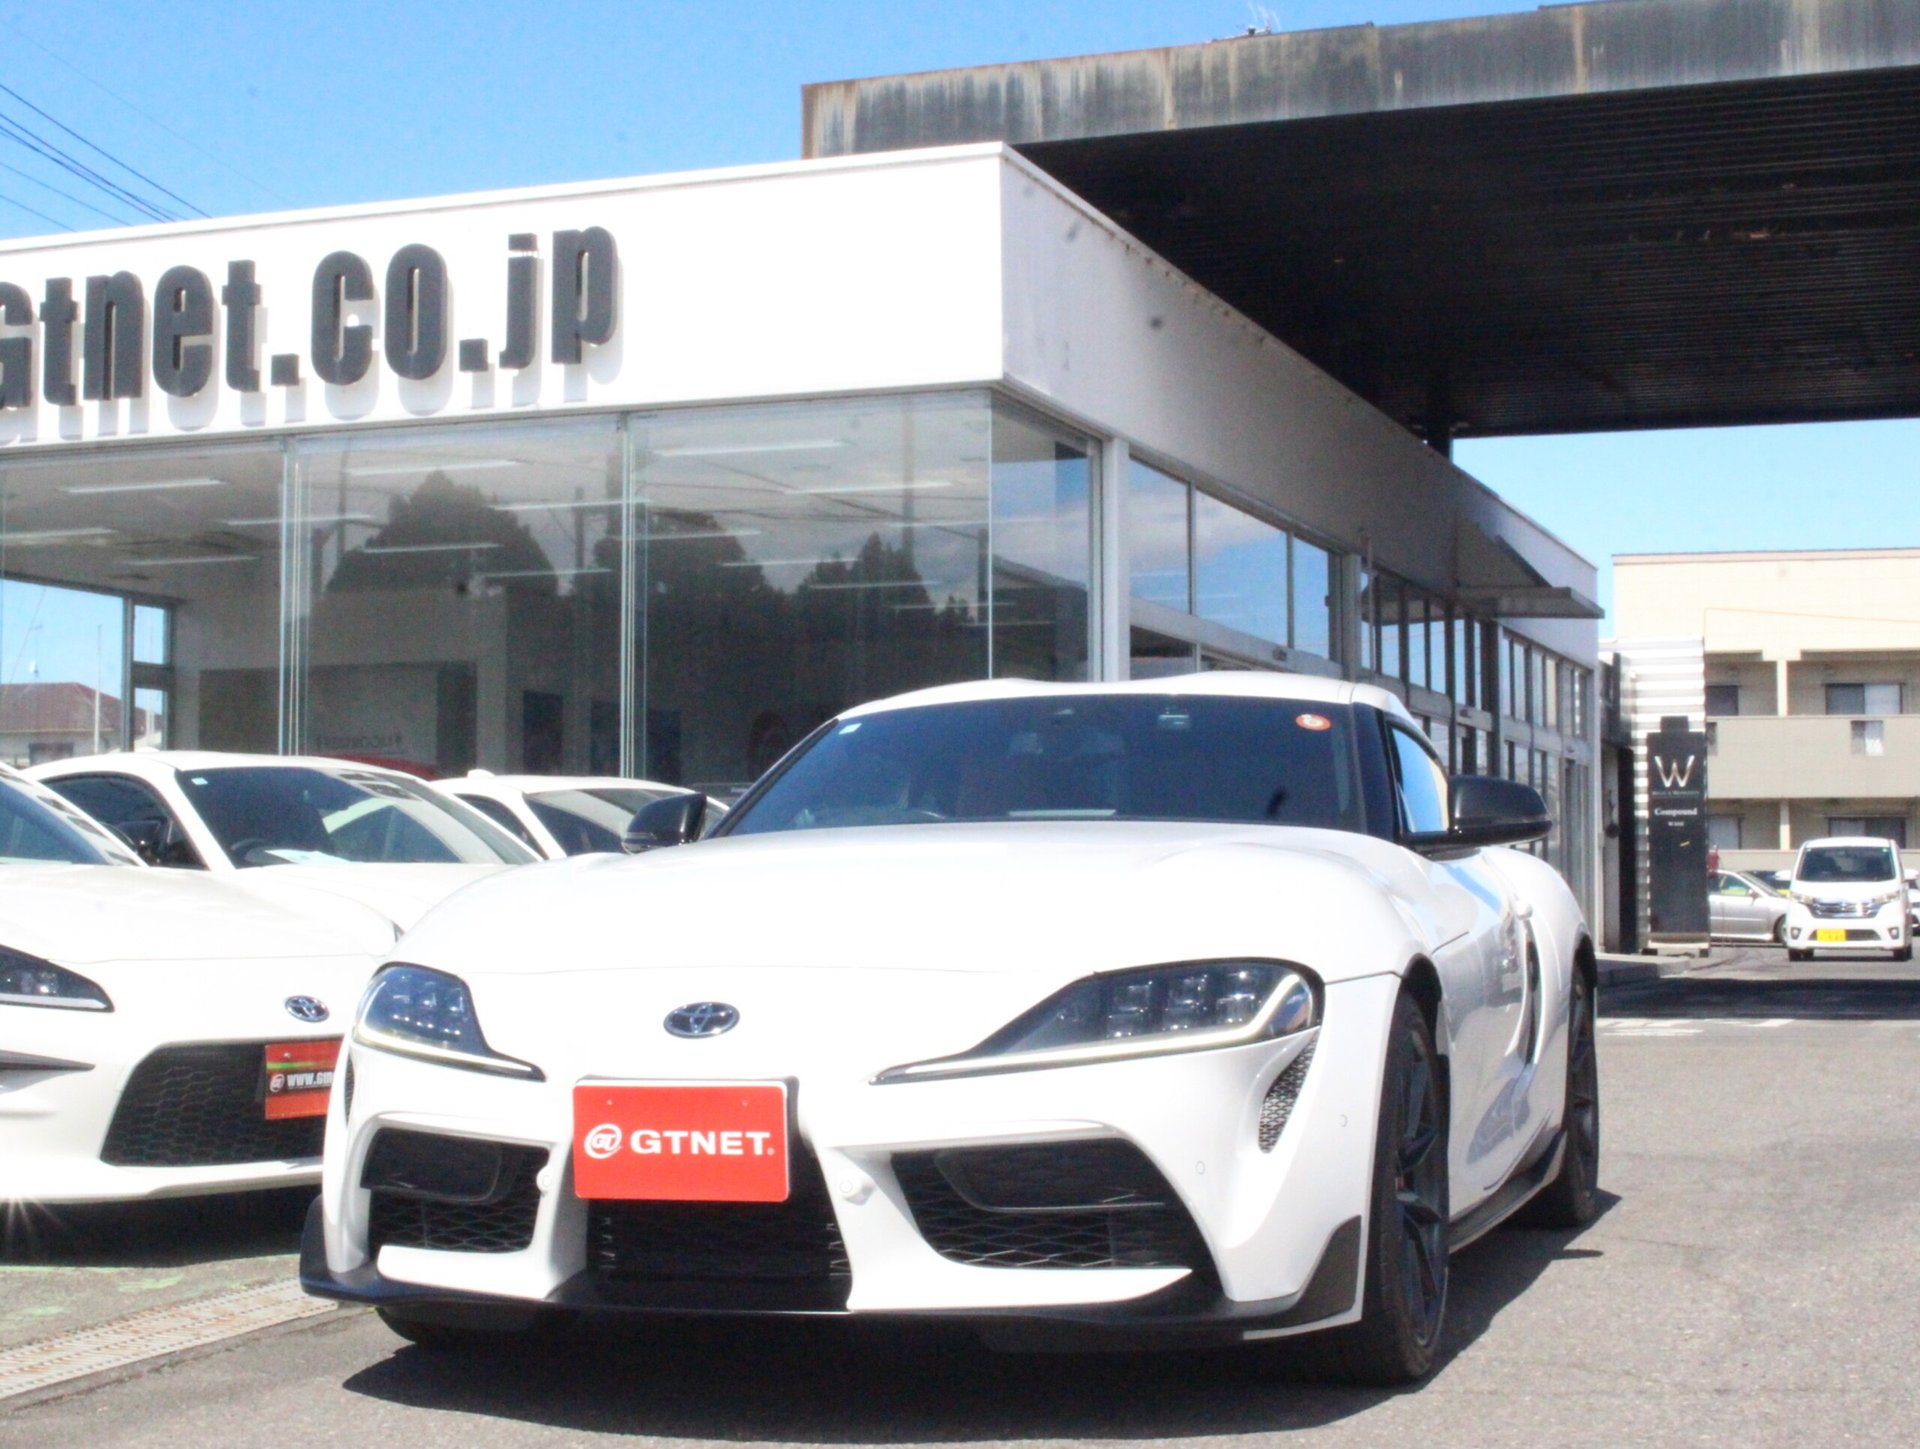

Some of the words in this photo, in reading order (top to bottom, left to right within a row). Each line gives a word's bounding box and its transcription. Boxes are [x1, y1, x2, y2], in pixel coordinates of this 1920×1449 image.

[1654, 754, 1695, 788] W
[1654, 807, 1698, 817] Compound
[630, 1129, 771, 1155] GTNET
